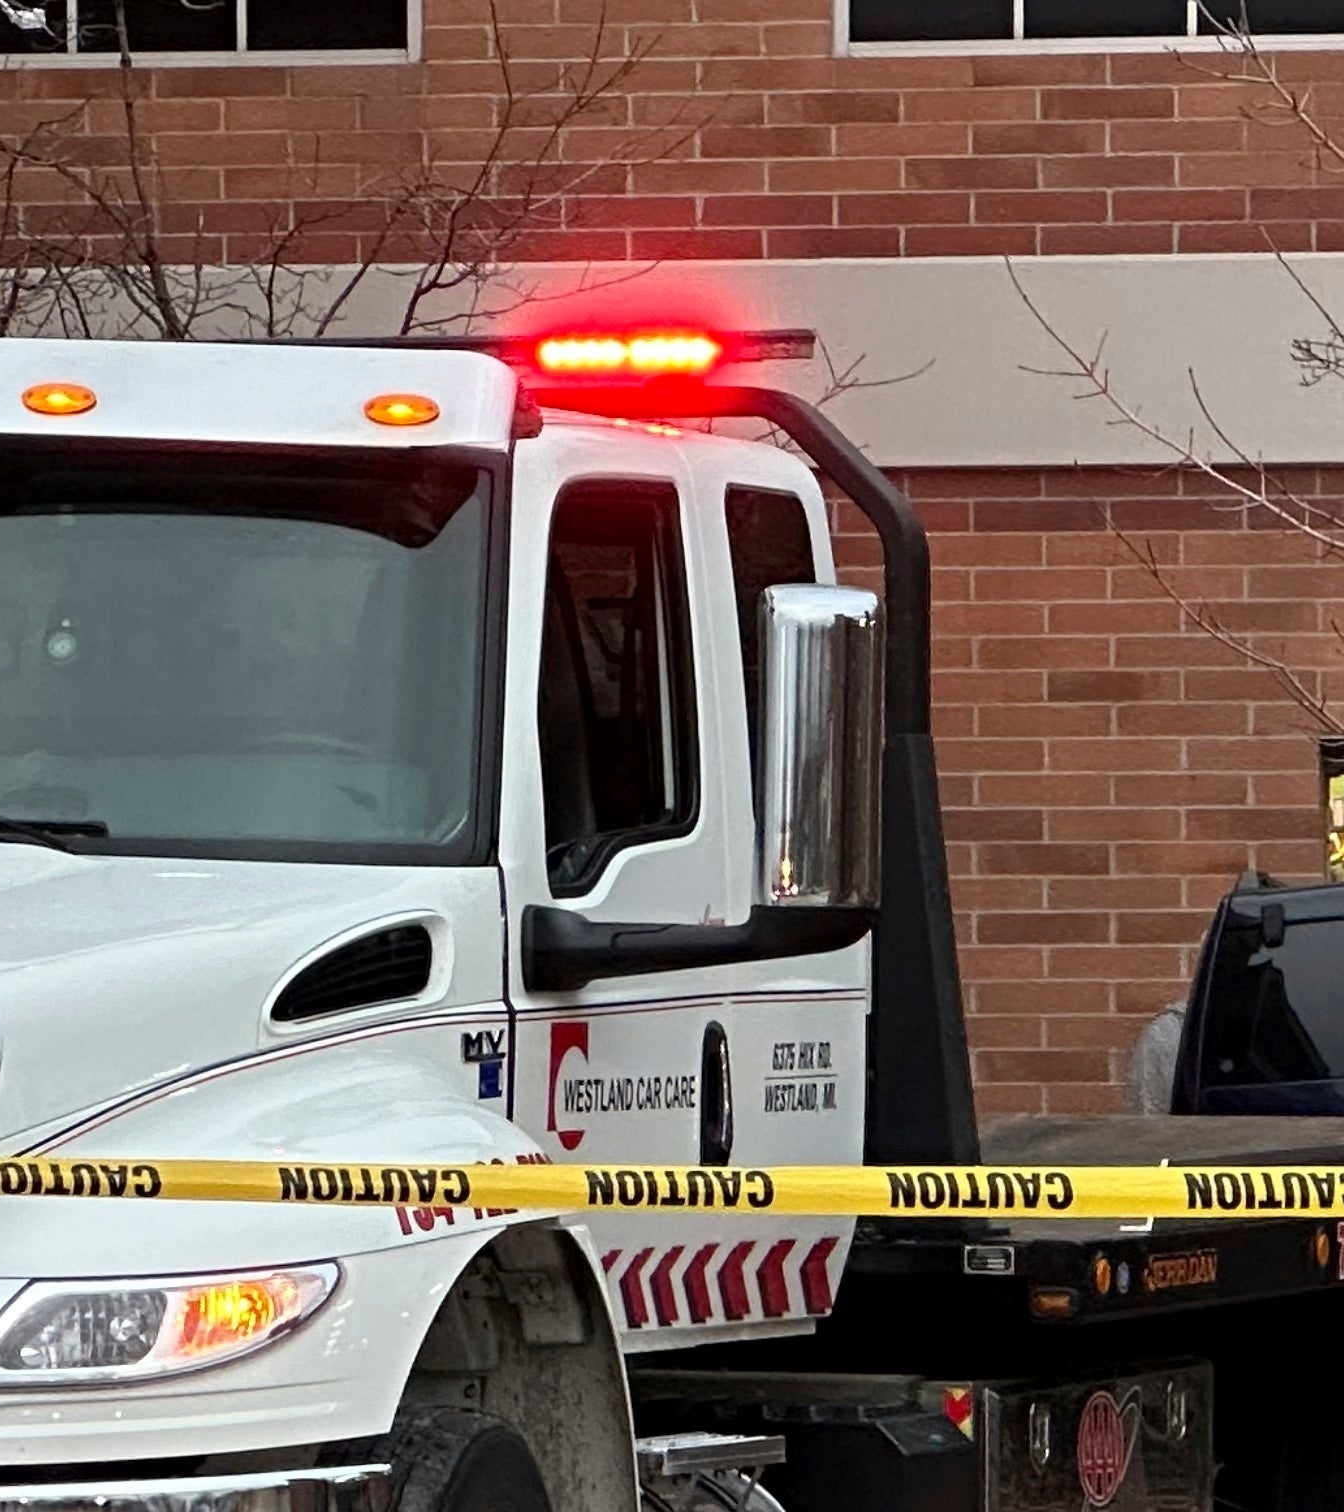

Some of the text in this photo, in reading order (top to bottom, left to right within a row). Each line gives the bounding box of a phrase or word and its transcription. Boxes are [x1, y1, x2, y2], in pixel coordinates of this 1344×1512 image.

[564, 1075, 696, 1113] WESTLAND CAR CARE
[279, 1167, 471, 1203] CAUTION
[586, 1170, 774, 1207] CAUTION
[887, 1172, 1074, 1211] CAUTION
